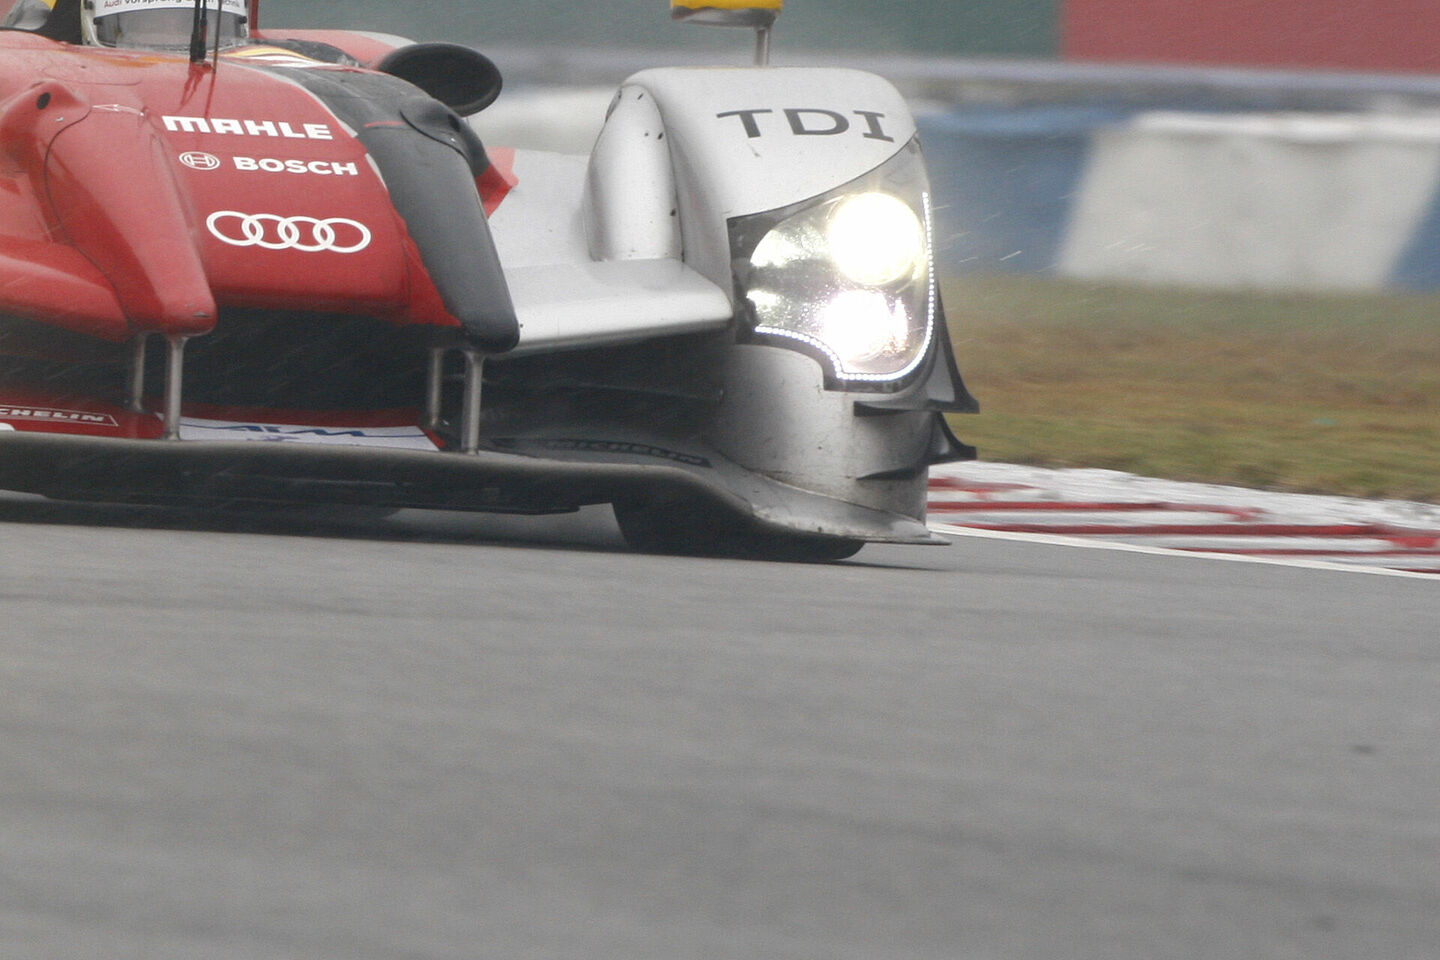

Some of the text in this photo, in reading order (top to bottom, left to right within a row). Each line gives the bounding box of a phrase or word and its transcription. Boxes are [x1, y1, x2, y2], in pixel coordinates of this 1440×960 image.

[161, 115, 333, 140] MAHLE
[716, 108, 894, 143] TDI
[232, 156, 359, 176] BOSCH
